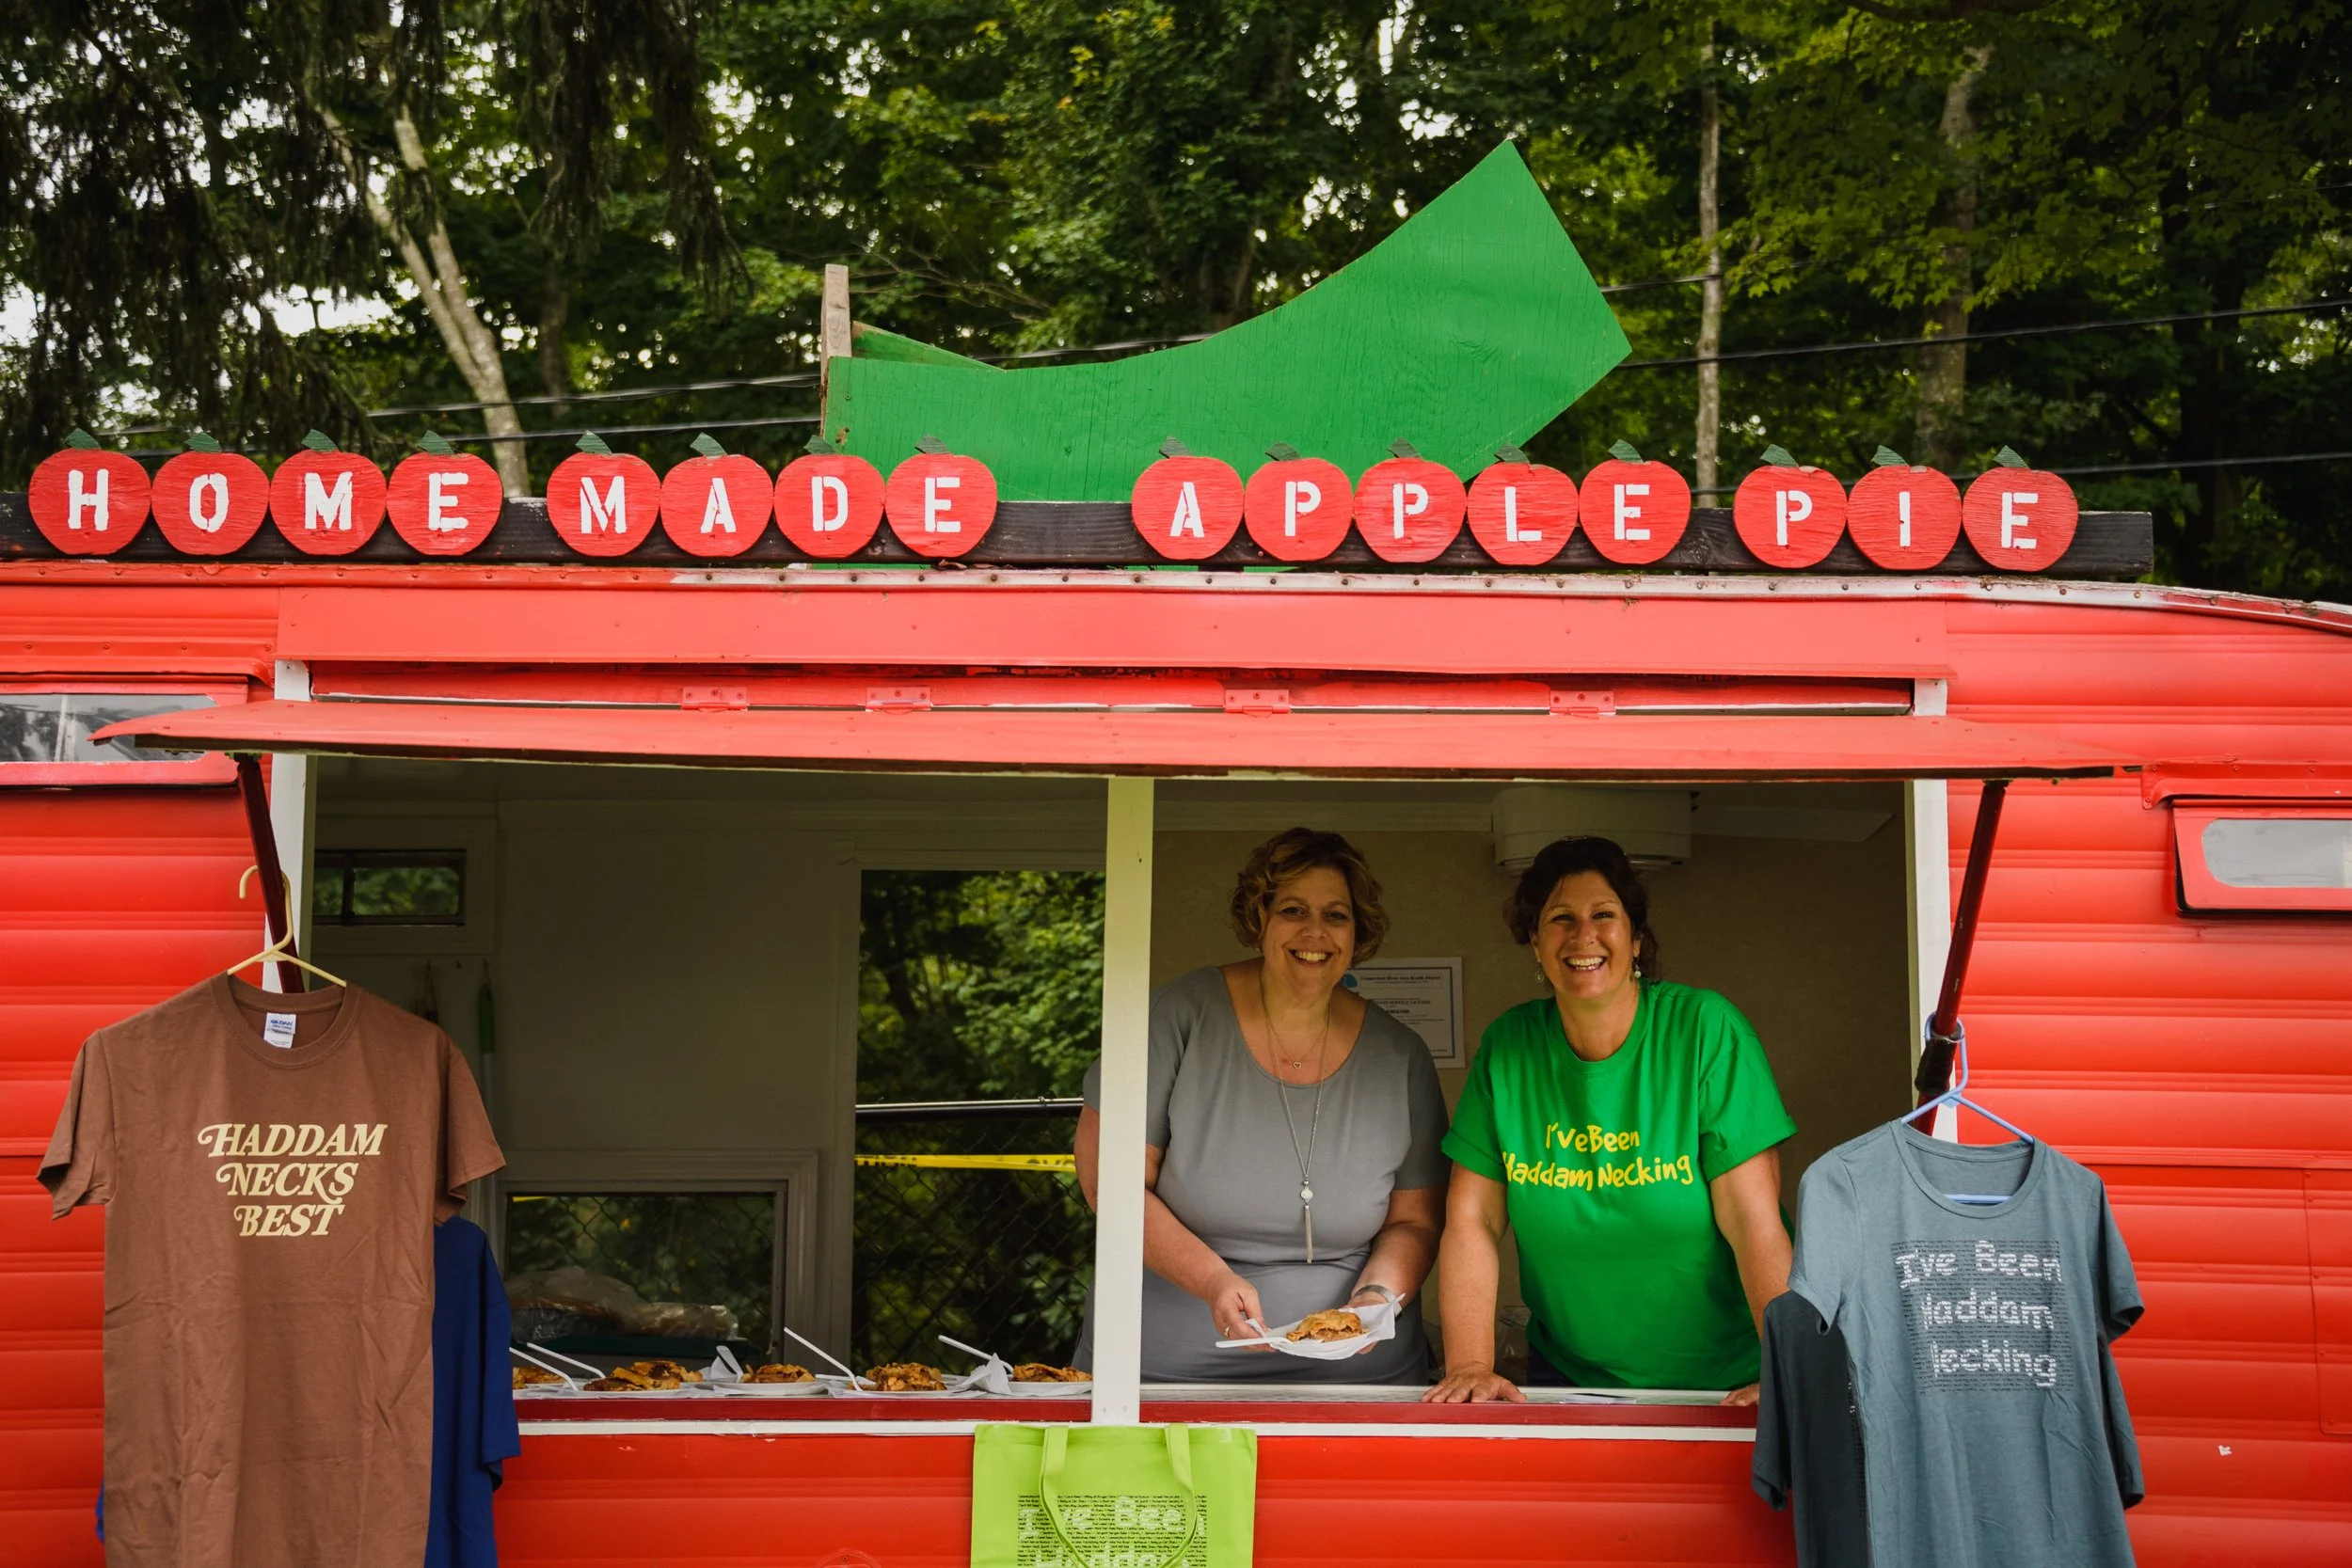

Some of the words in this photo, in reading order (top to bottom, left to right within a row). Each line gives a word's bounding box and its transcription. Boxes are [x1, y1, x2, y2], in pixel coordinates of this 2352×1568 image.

[69, 468, 469, 533] HOME
[580, 475, 961, 534] MADE
[1169, 481, 1651, 543] APPLE
[1775, 490, 2039, 549] PIE
[198, 1123, 388, 1157] HADDAM
[215, 1163, 358, 1205] NECKS
[233, 1204, 345, 1237] BEST
[1975, 1240, 2062, 1282] Been
